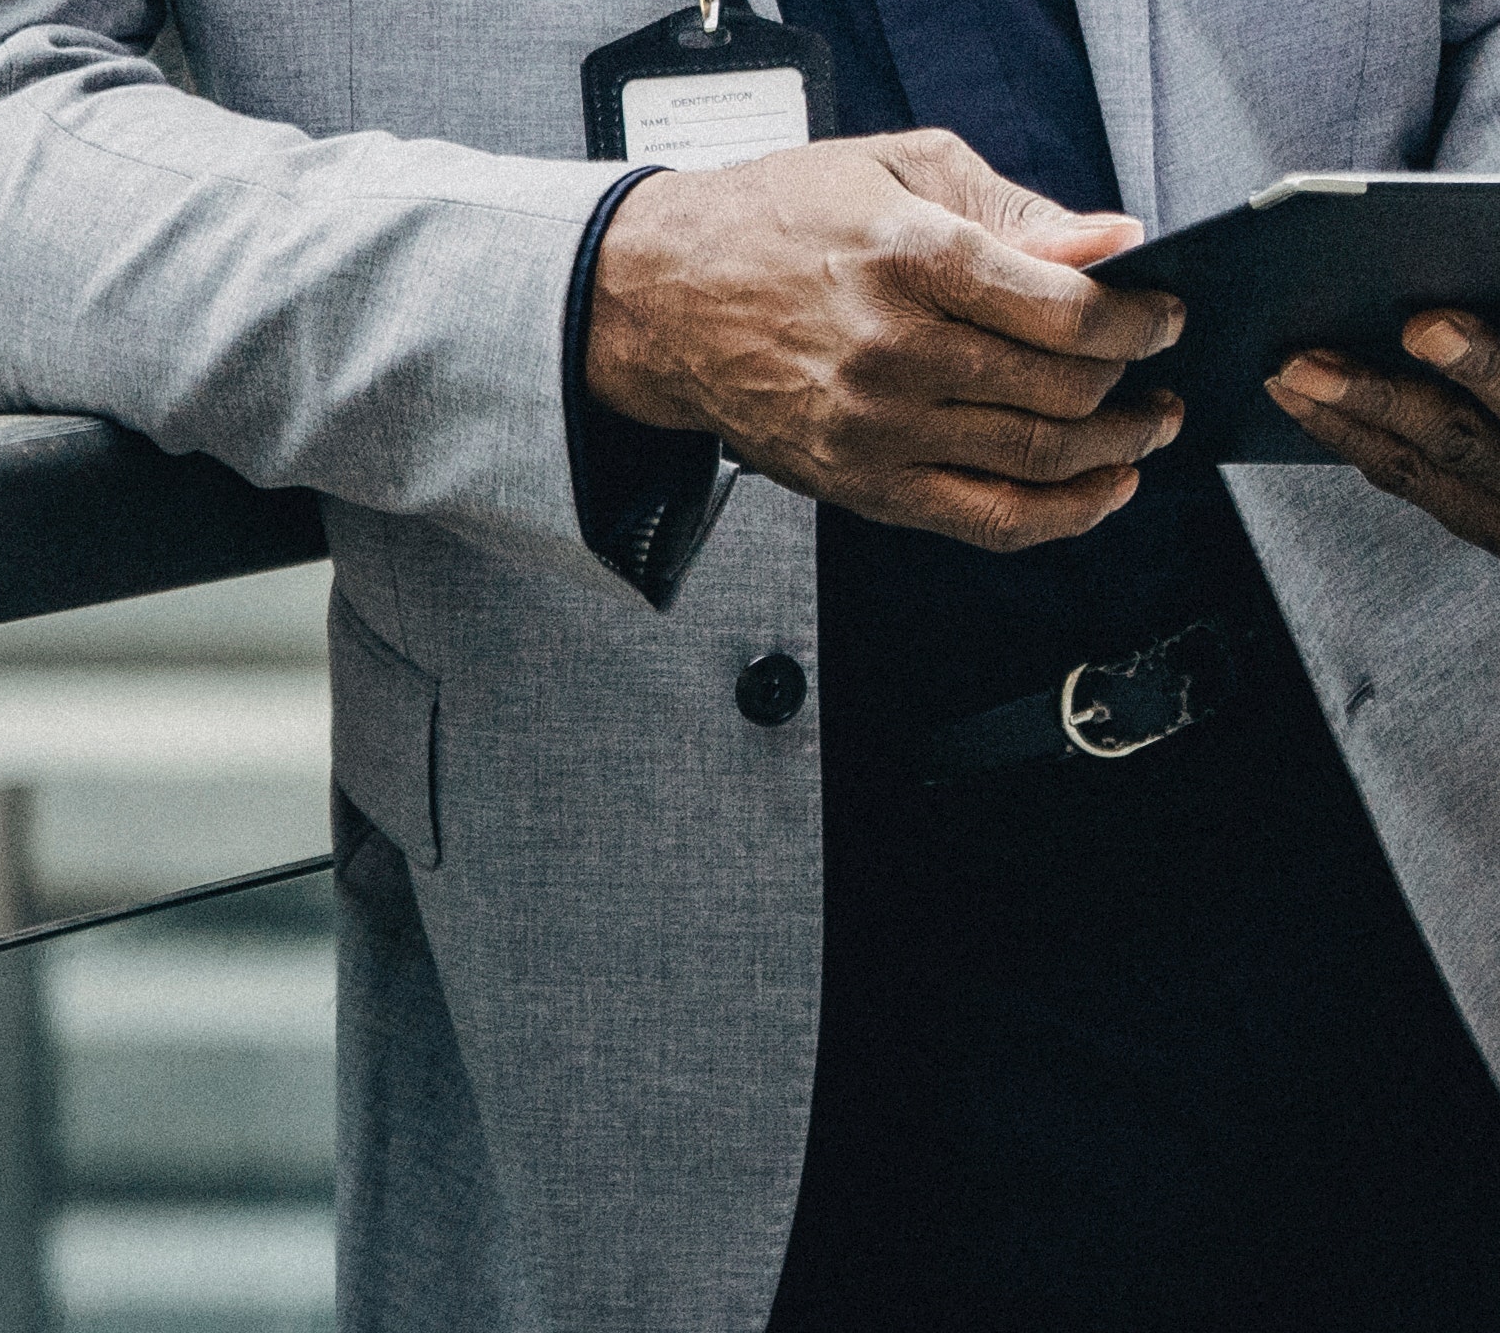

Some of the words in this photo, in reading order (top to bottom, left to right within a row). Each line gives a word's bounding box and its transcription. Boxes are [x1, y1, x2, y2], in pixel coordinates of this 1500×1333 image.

[671, 90, 753, 108] IDENTIFICATION
[640, 116, 670, 127] NAME
[643, 139, 692, 153] ADDRESS
